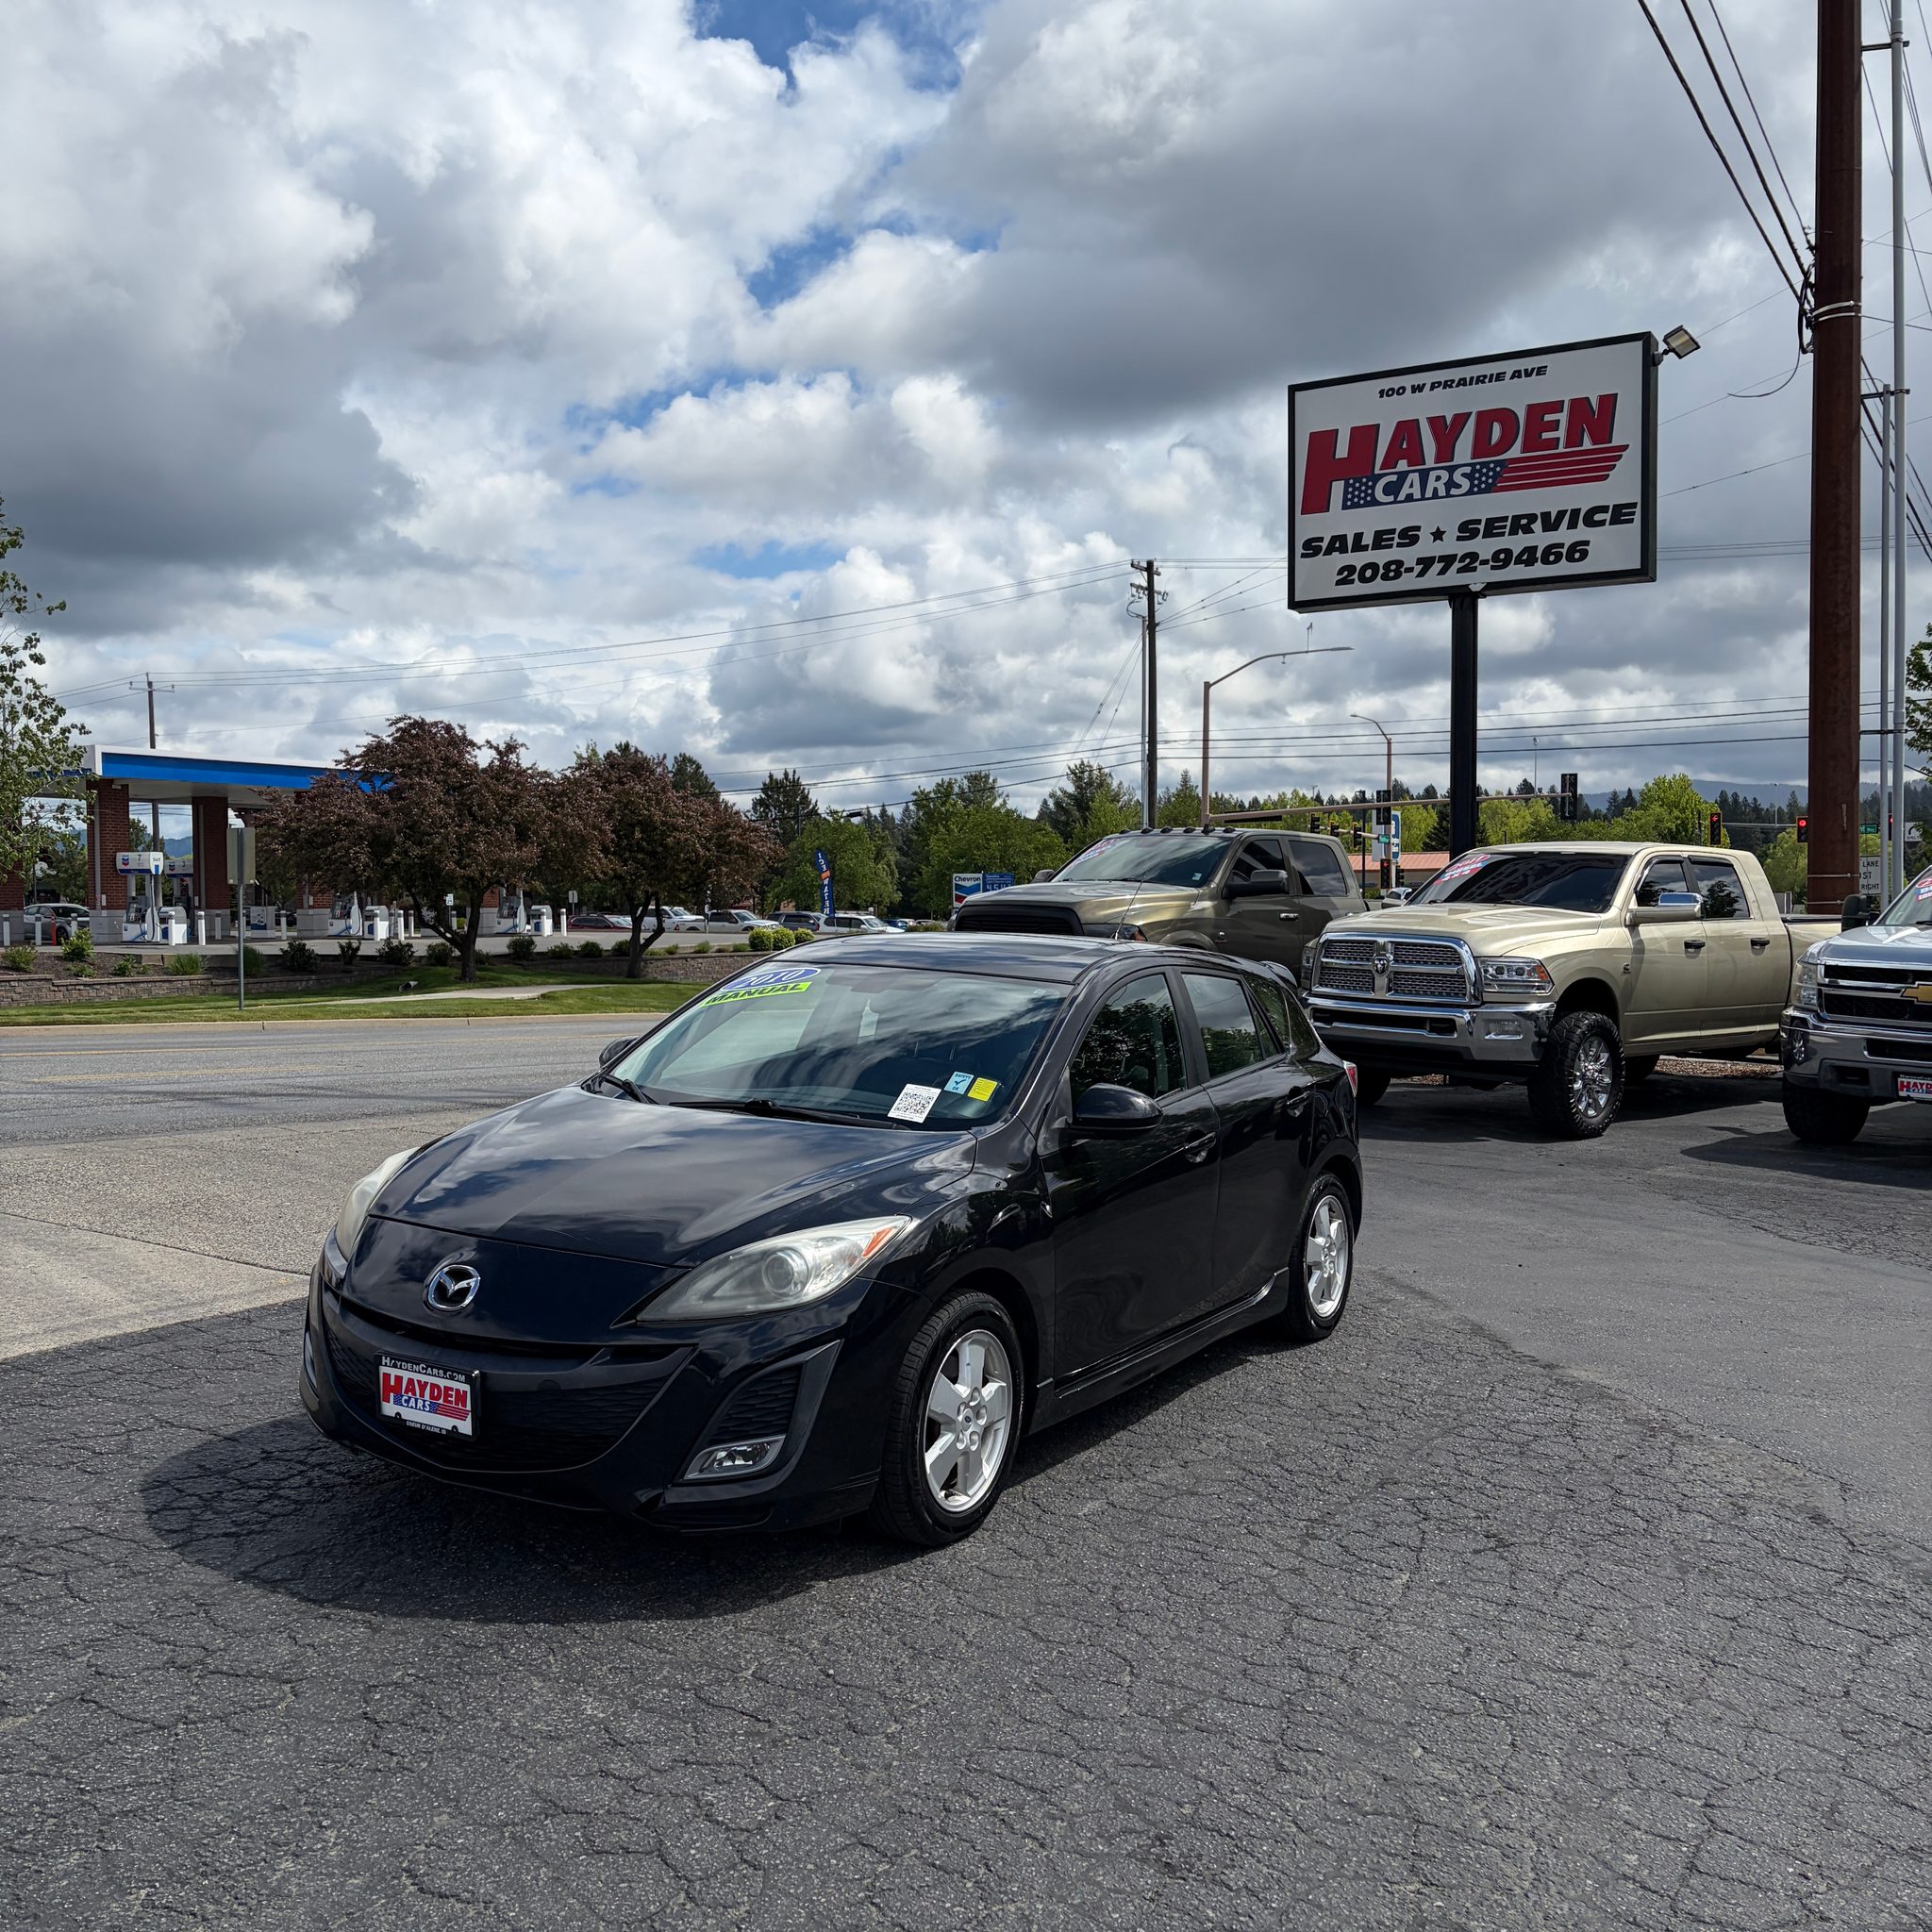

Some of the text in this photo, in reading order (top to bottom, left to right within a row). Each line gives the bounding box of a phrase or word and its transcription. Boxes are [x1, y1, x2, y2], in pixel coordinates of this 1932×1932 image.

[1378, 365, 1548, 399] 100 W PRAIRIE AVE
[1300, 392, 1618, 515] HAYDEN
[1374, 466, 1474, 503] CARS
[1300, 502, 1638, 558] SALES SERVICE
[1335, 540, 1591, 586] 208-772-9466
[705, 983, 803, 1006] MANUAL
[735, 969, 806, 989] 2010
[382, 1372, 468, 1408] HAYDEN
[401, 1395, 432, 1411] CARS
